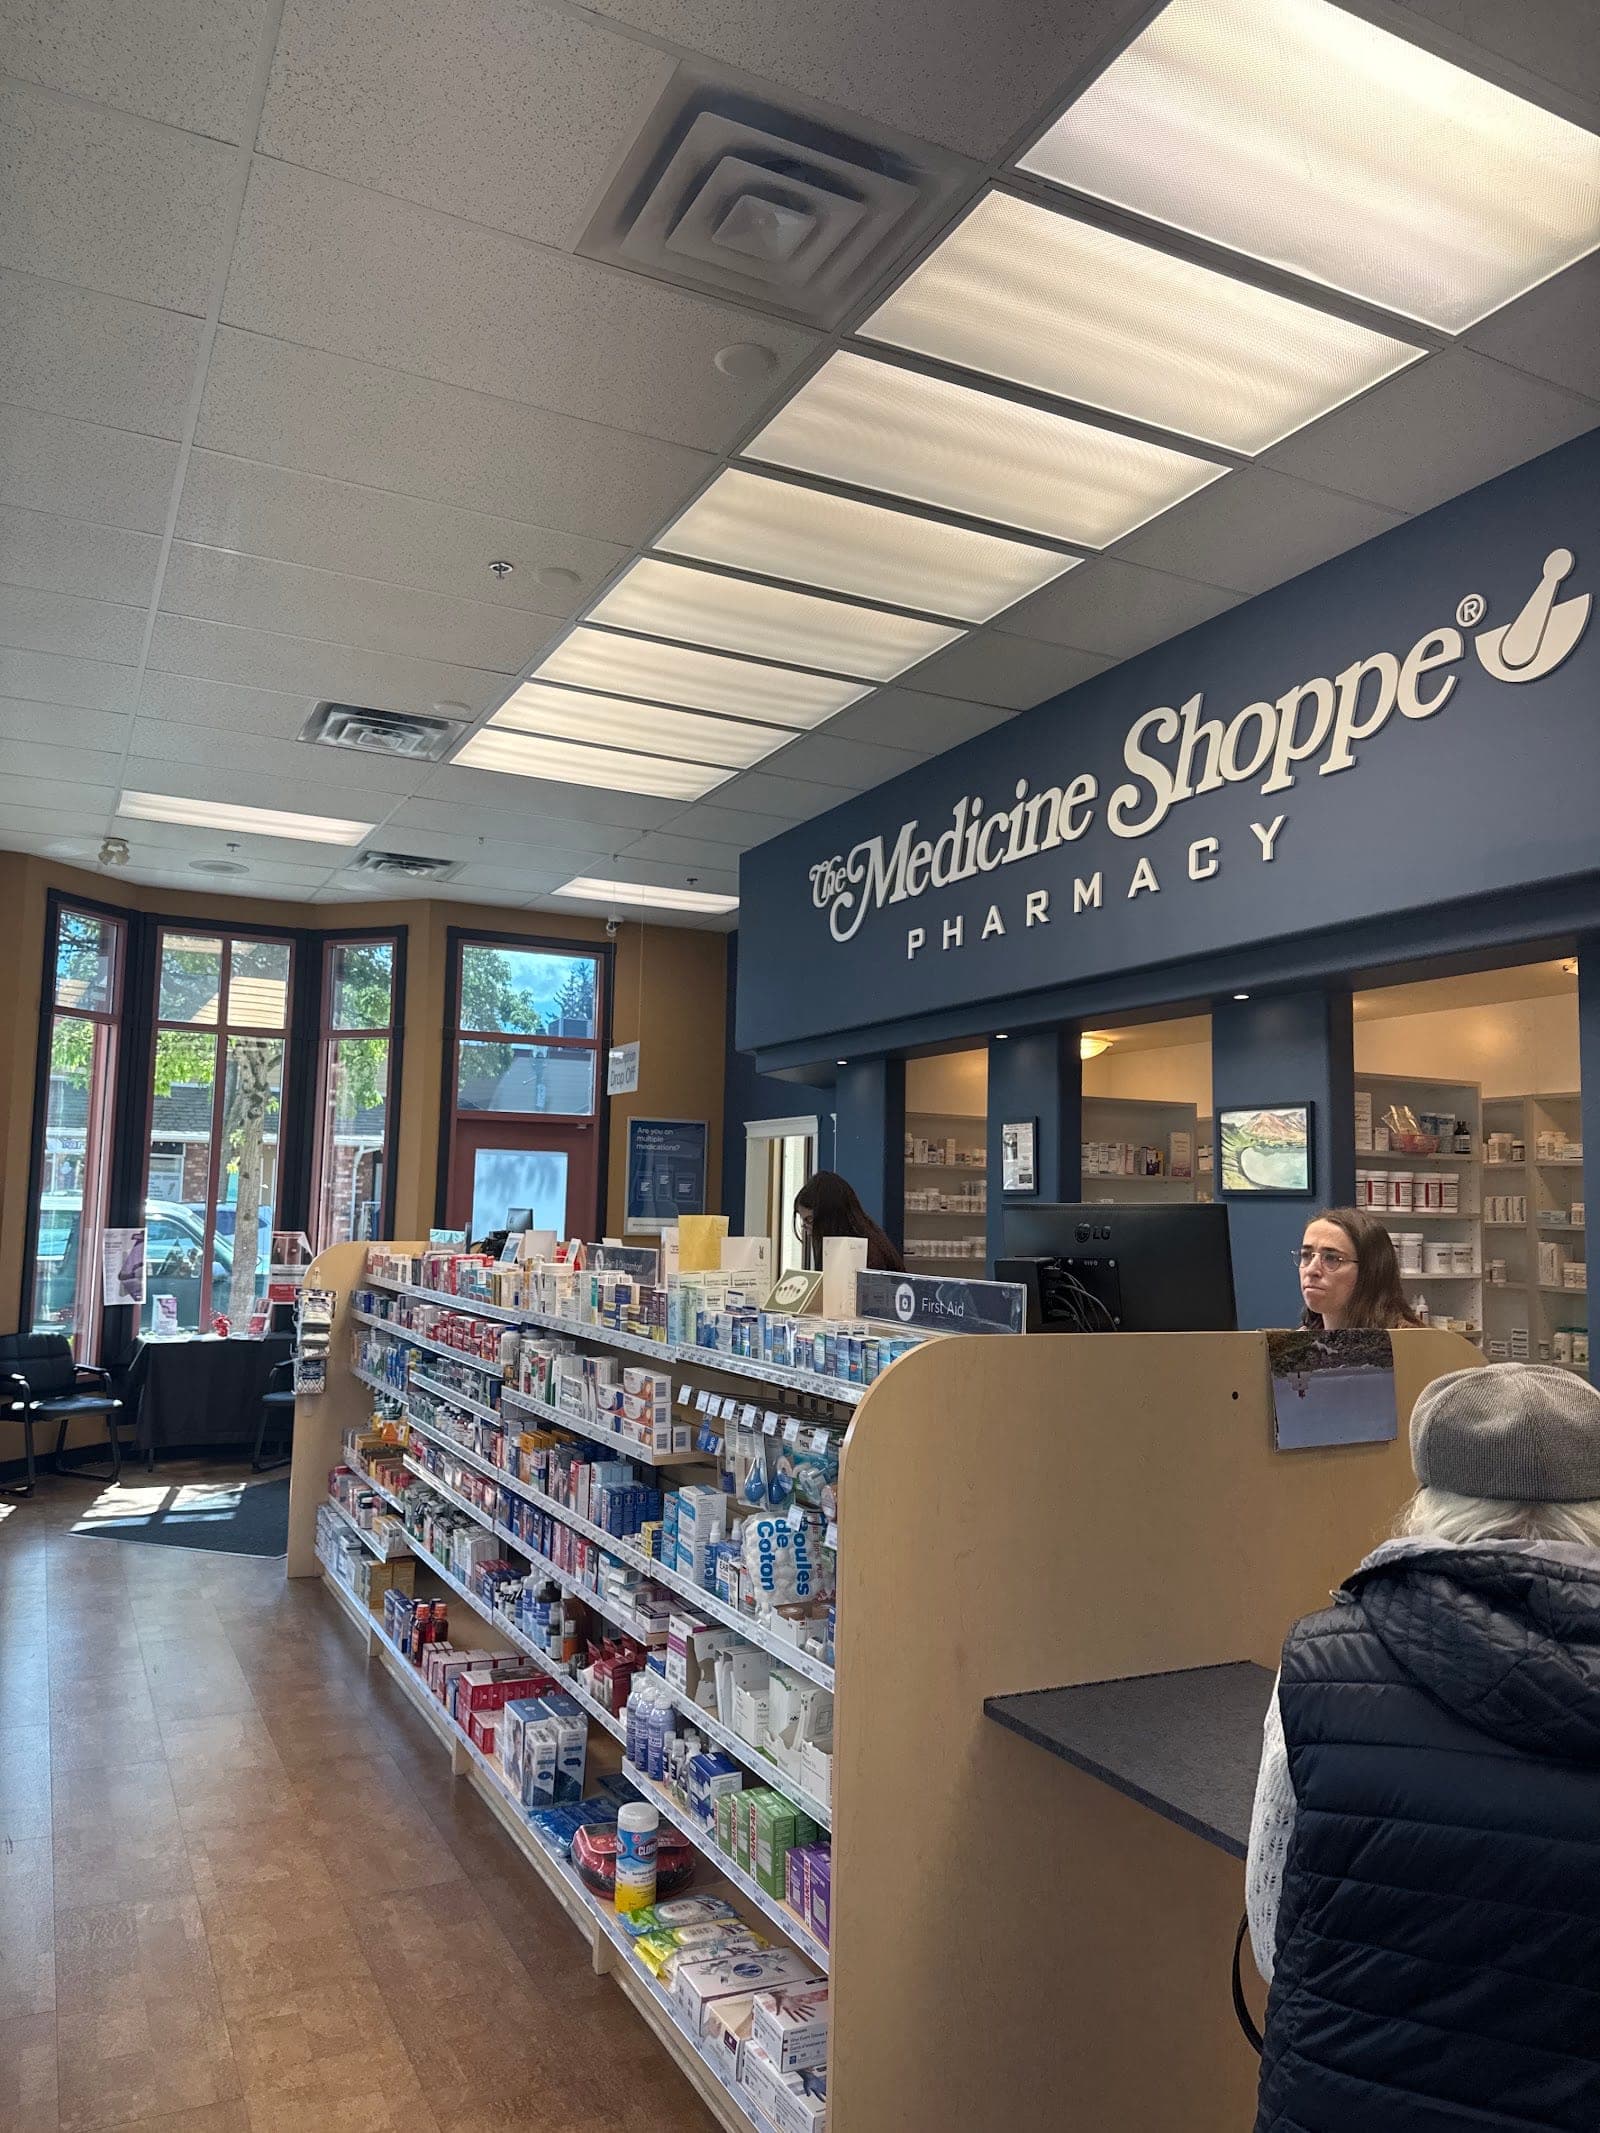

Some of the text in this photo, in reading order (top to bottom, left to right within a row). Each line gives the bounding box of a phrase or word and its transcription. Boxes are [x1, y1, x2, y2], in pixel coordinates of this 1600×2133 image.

[828, 772, 1100, 942] Medicine
[808, 853, 850, 911] The
[906, 813, 1292, 960] PHARMACY
[650, 1128, 664, 1136] you
[1092, 1225, 1111, 1240] LG
[921, 1297, 965, 1317] First Aid
[775, 1519, 791, 1548] de
[757, 1521, 775, 1590] Coton
